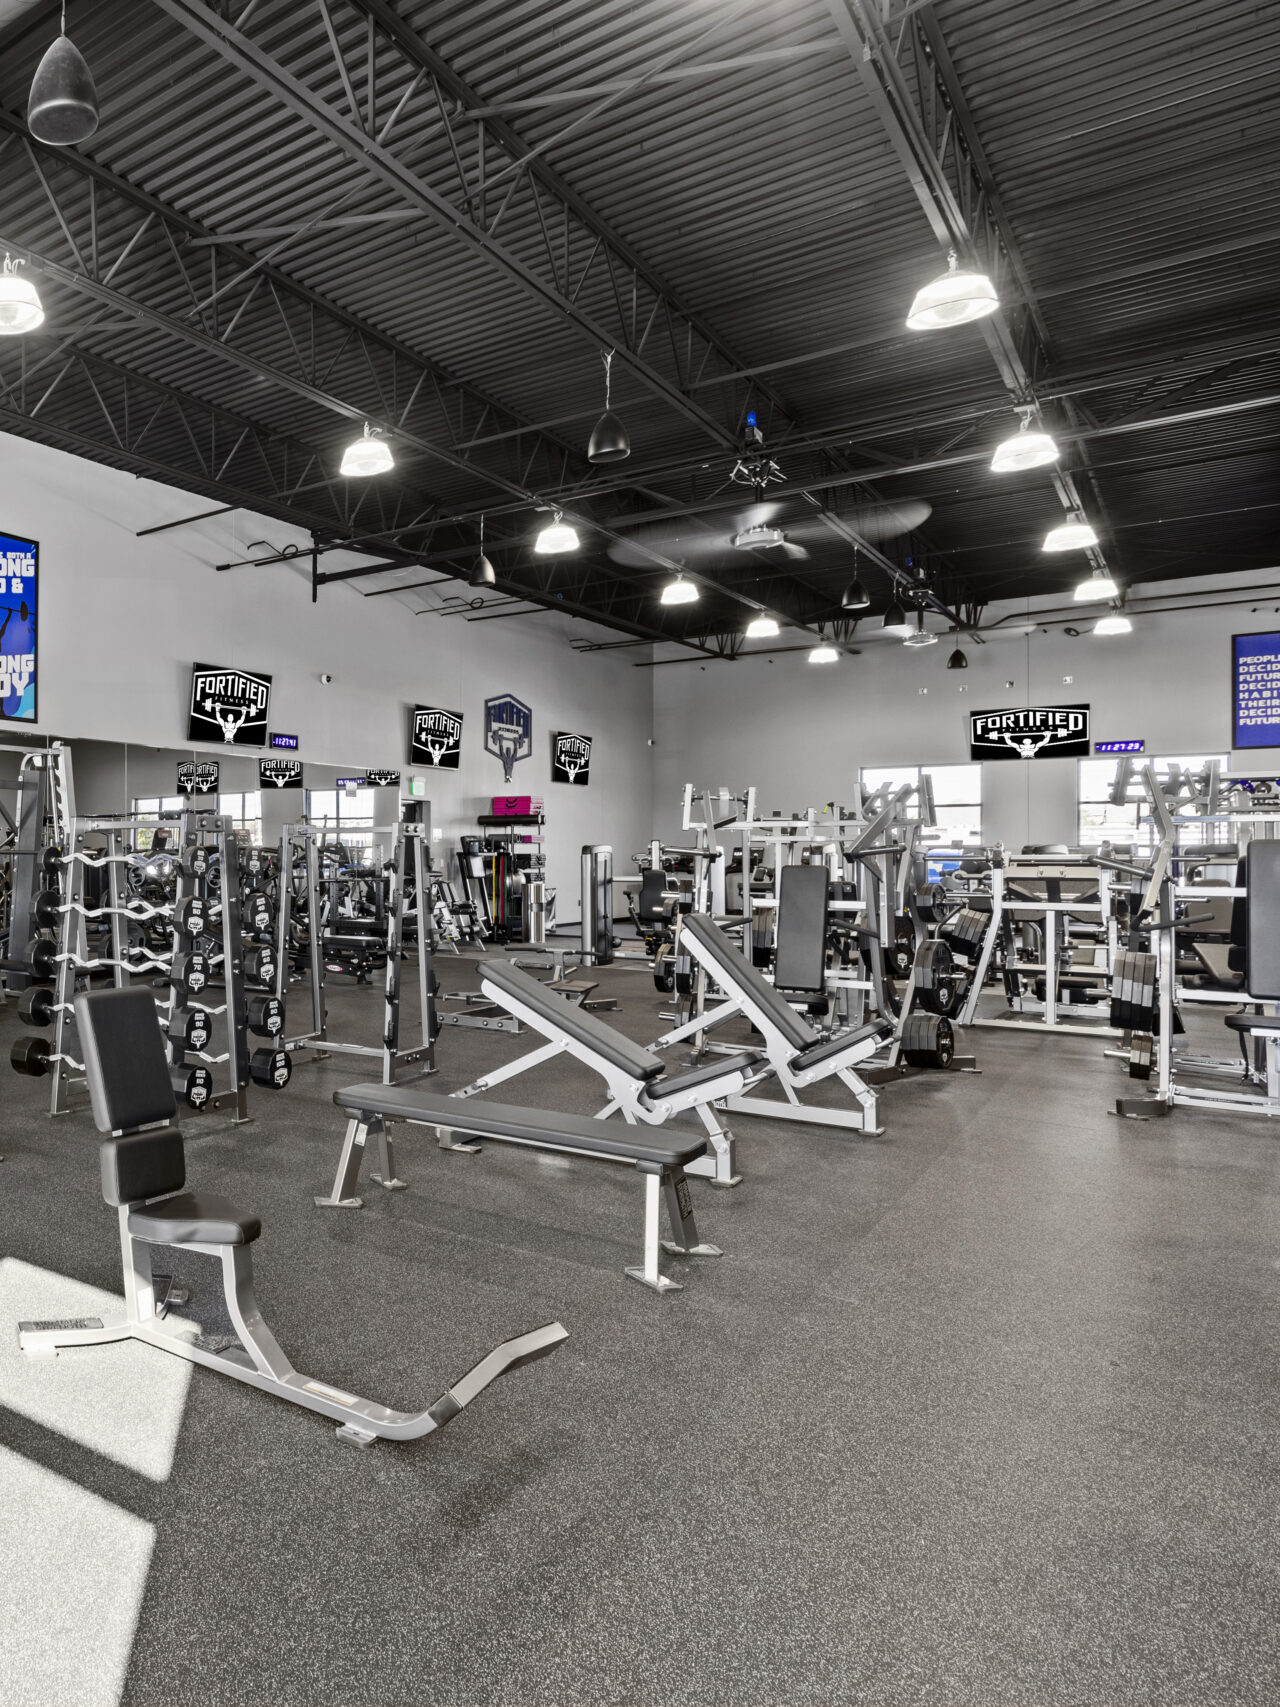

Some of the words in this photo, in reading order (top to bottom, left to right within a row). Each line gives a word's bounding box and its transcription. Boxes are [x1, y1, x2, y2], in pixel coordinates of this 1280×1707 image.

[11, 577, 24, 593] &
[1239, 654, 1280, 664] PEOPL
[196, 675, 267, 709] FORTIFIED
[1239, 690, 1280, 699] HABI
[416, 714, 460, 741] FORTIFIED
[976, 711, 1083, 735] FORTIFIED
[557, 738, 590, 760] FORTIFIED
[261, 760, 300, 773] FORTIFIED
